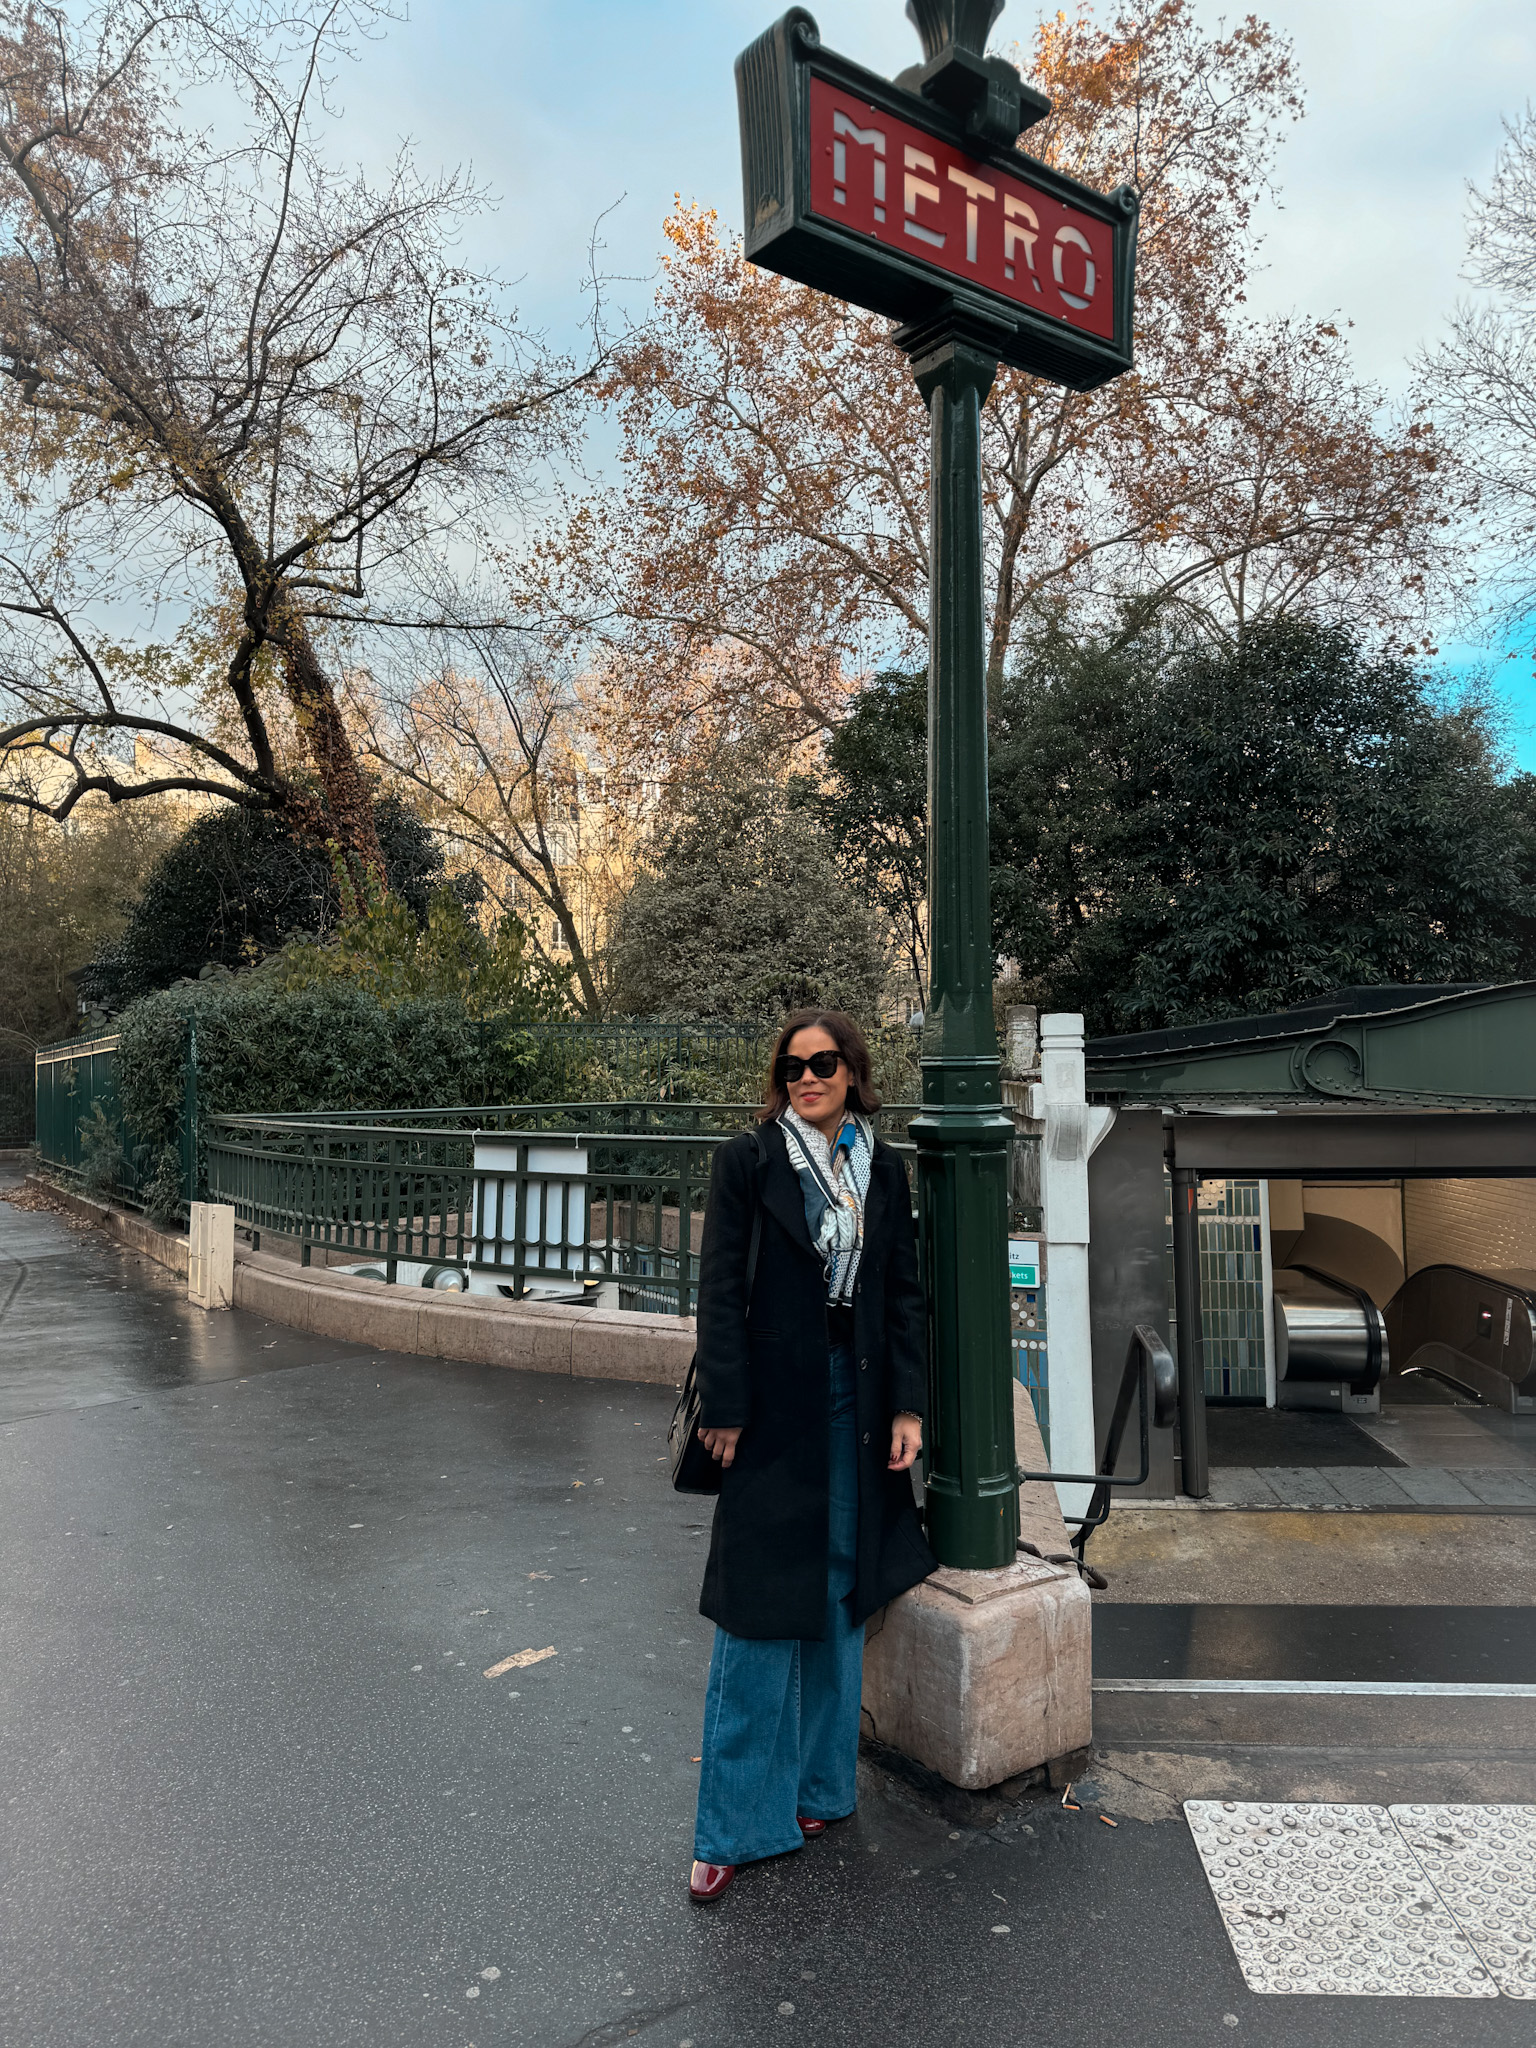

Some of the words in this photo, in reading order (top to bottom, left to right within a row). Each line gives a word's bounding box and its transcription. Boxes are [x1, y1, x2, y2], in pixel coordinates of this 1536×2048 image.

[832, 108, 1096, 311] METRO
[1009, 1251, 1020, 1260] itz
[1011, 1271, 1029, 1280] kets
